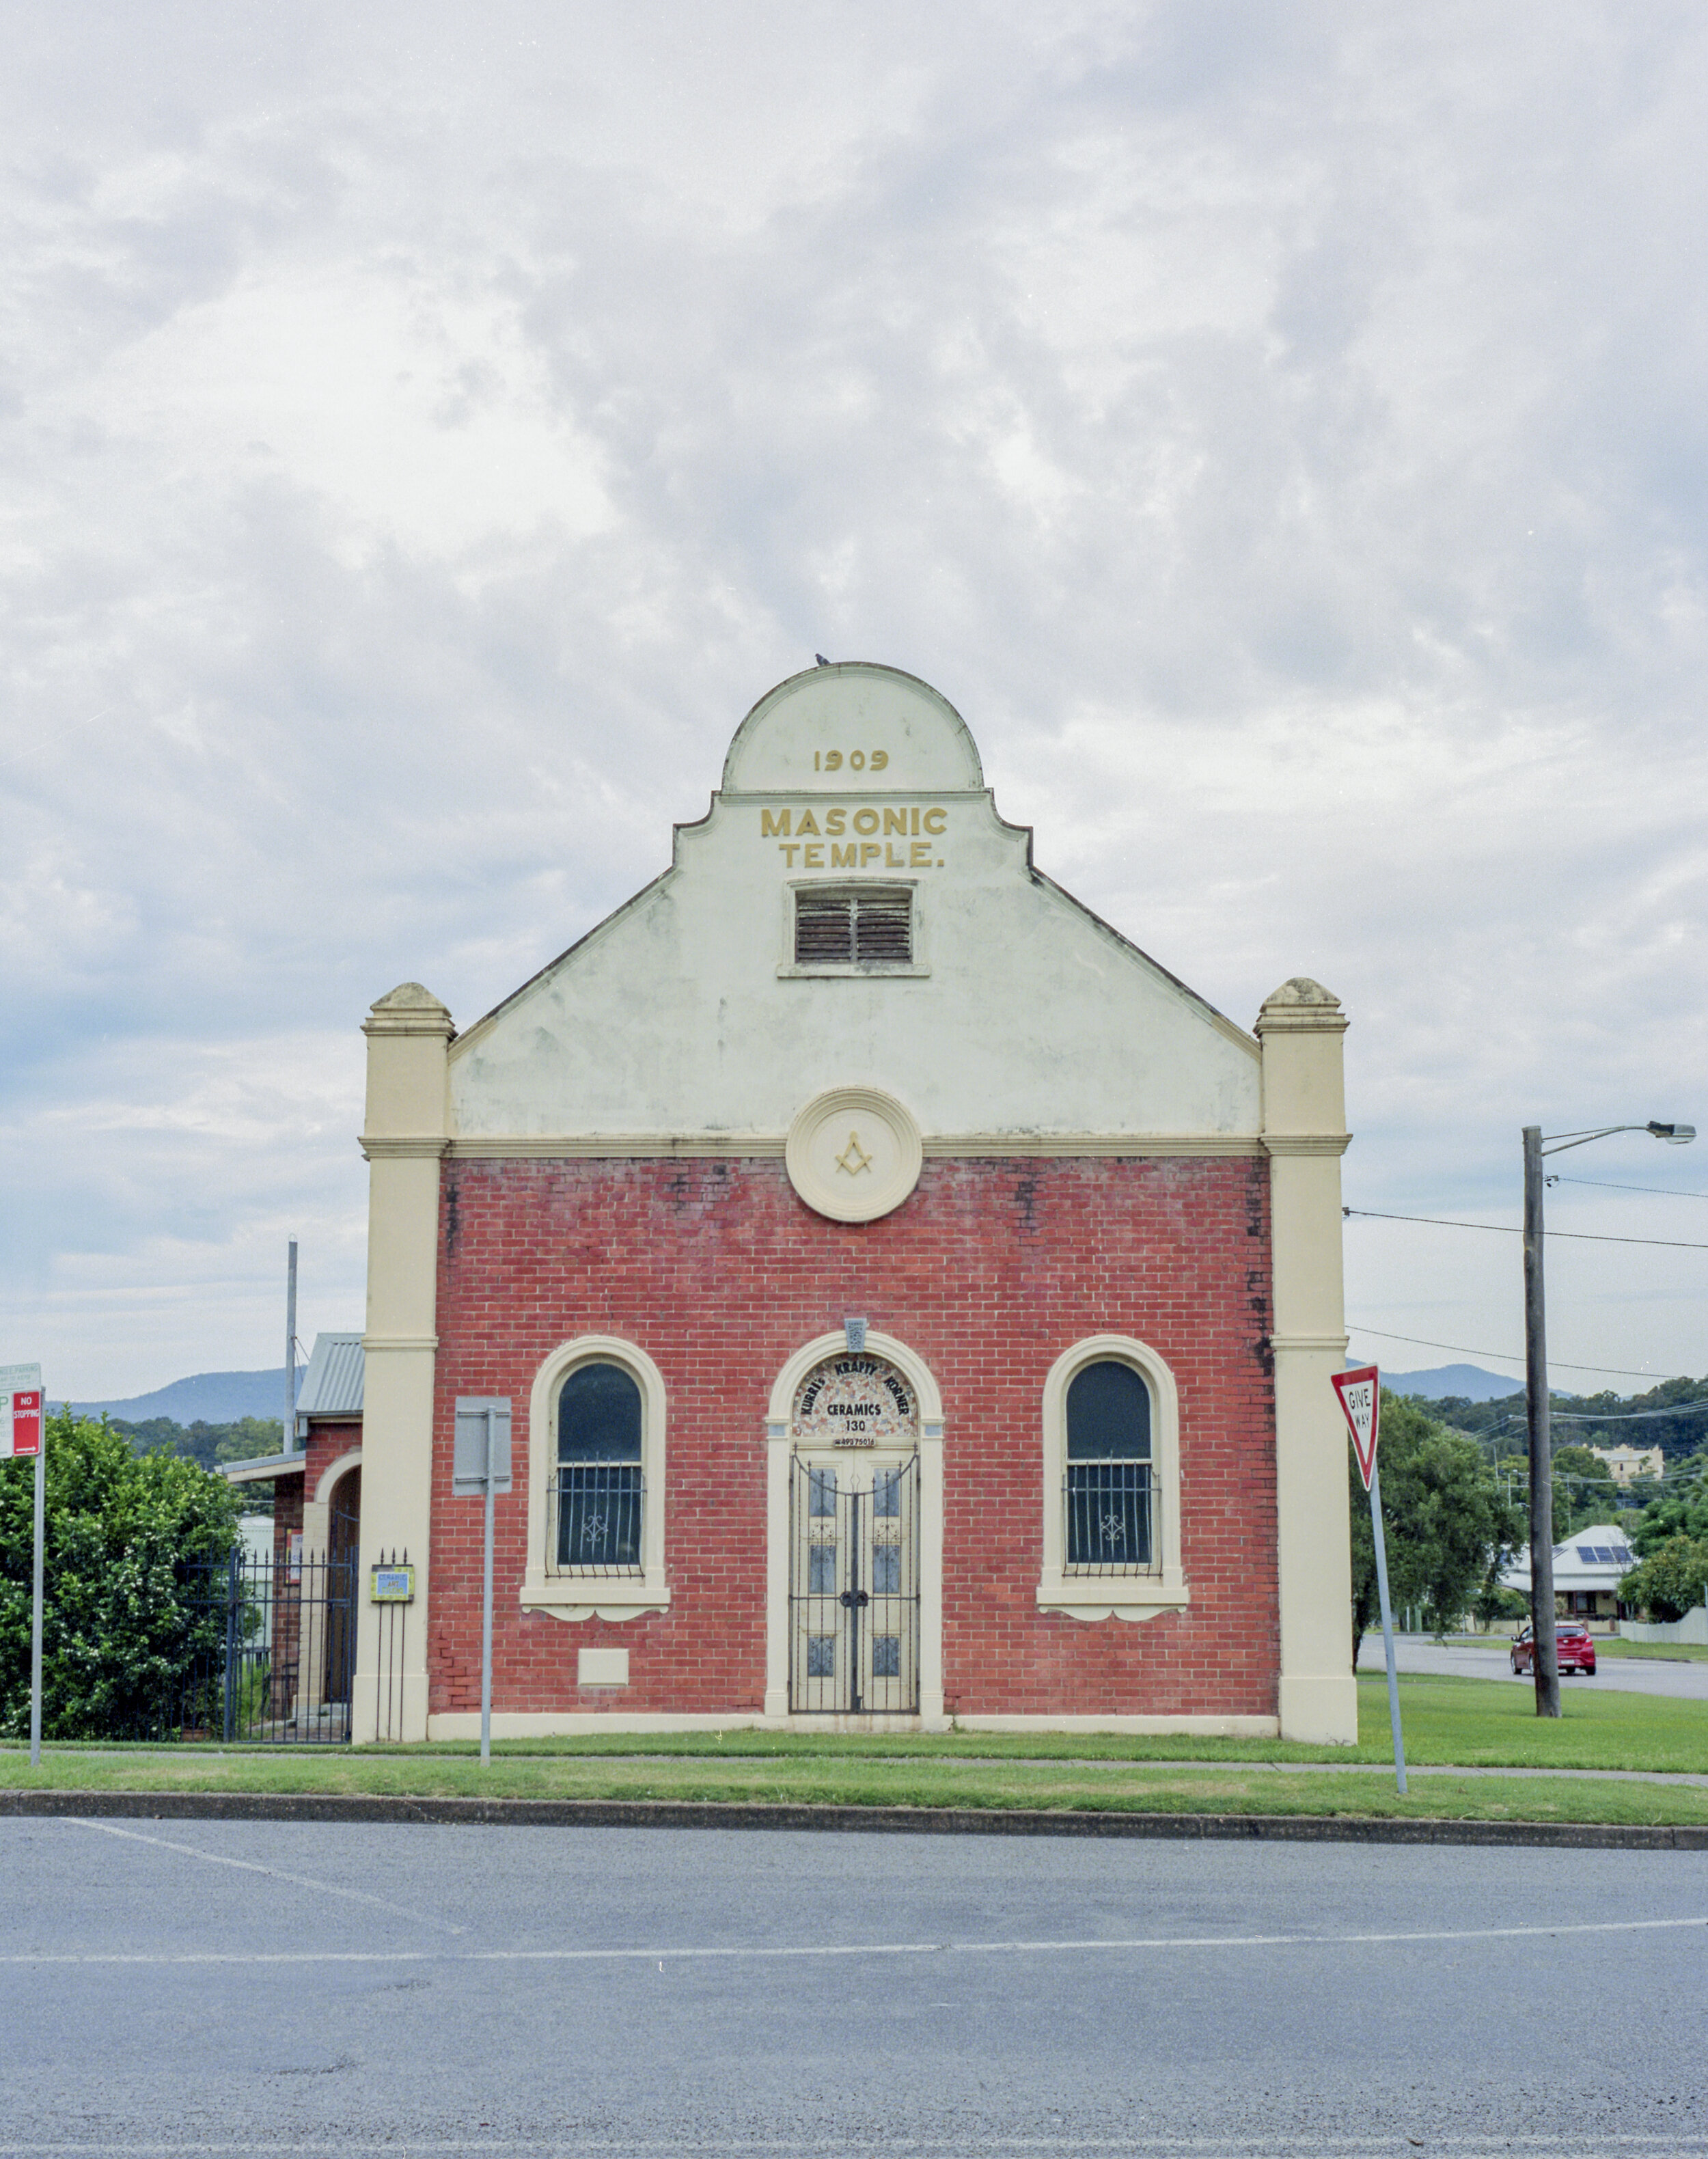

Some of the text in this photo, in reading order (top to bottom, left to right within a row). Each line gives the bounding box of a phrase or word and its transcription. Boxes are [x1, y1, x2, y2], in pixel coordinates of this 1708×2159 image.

[814, 750, 889, 771] 1909
[760, 808, 948, 836] MASONIC
[779, 842, 944, 868] TEMPLE.
[834, 1360, 878, 1375] KRAFTY
[883, 1376, 909, 1416] KORNER
[20, 1397, 32, 1405] NO
[1349, 1388, 1370, 1409] GIVE
[14, 1409, 39, 1419] STOPPING
[827, 1404, 881, 1416] CERAMICS
[846, 1420, 866, 1431] 130
[1354, 1413, 1370, 1429] WAY
